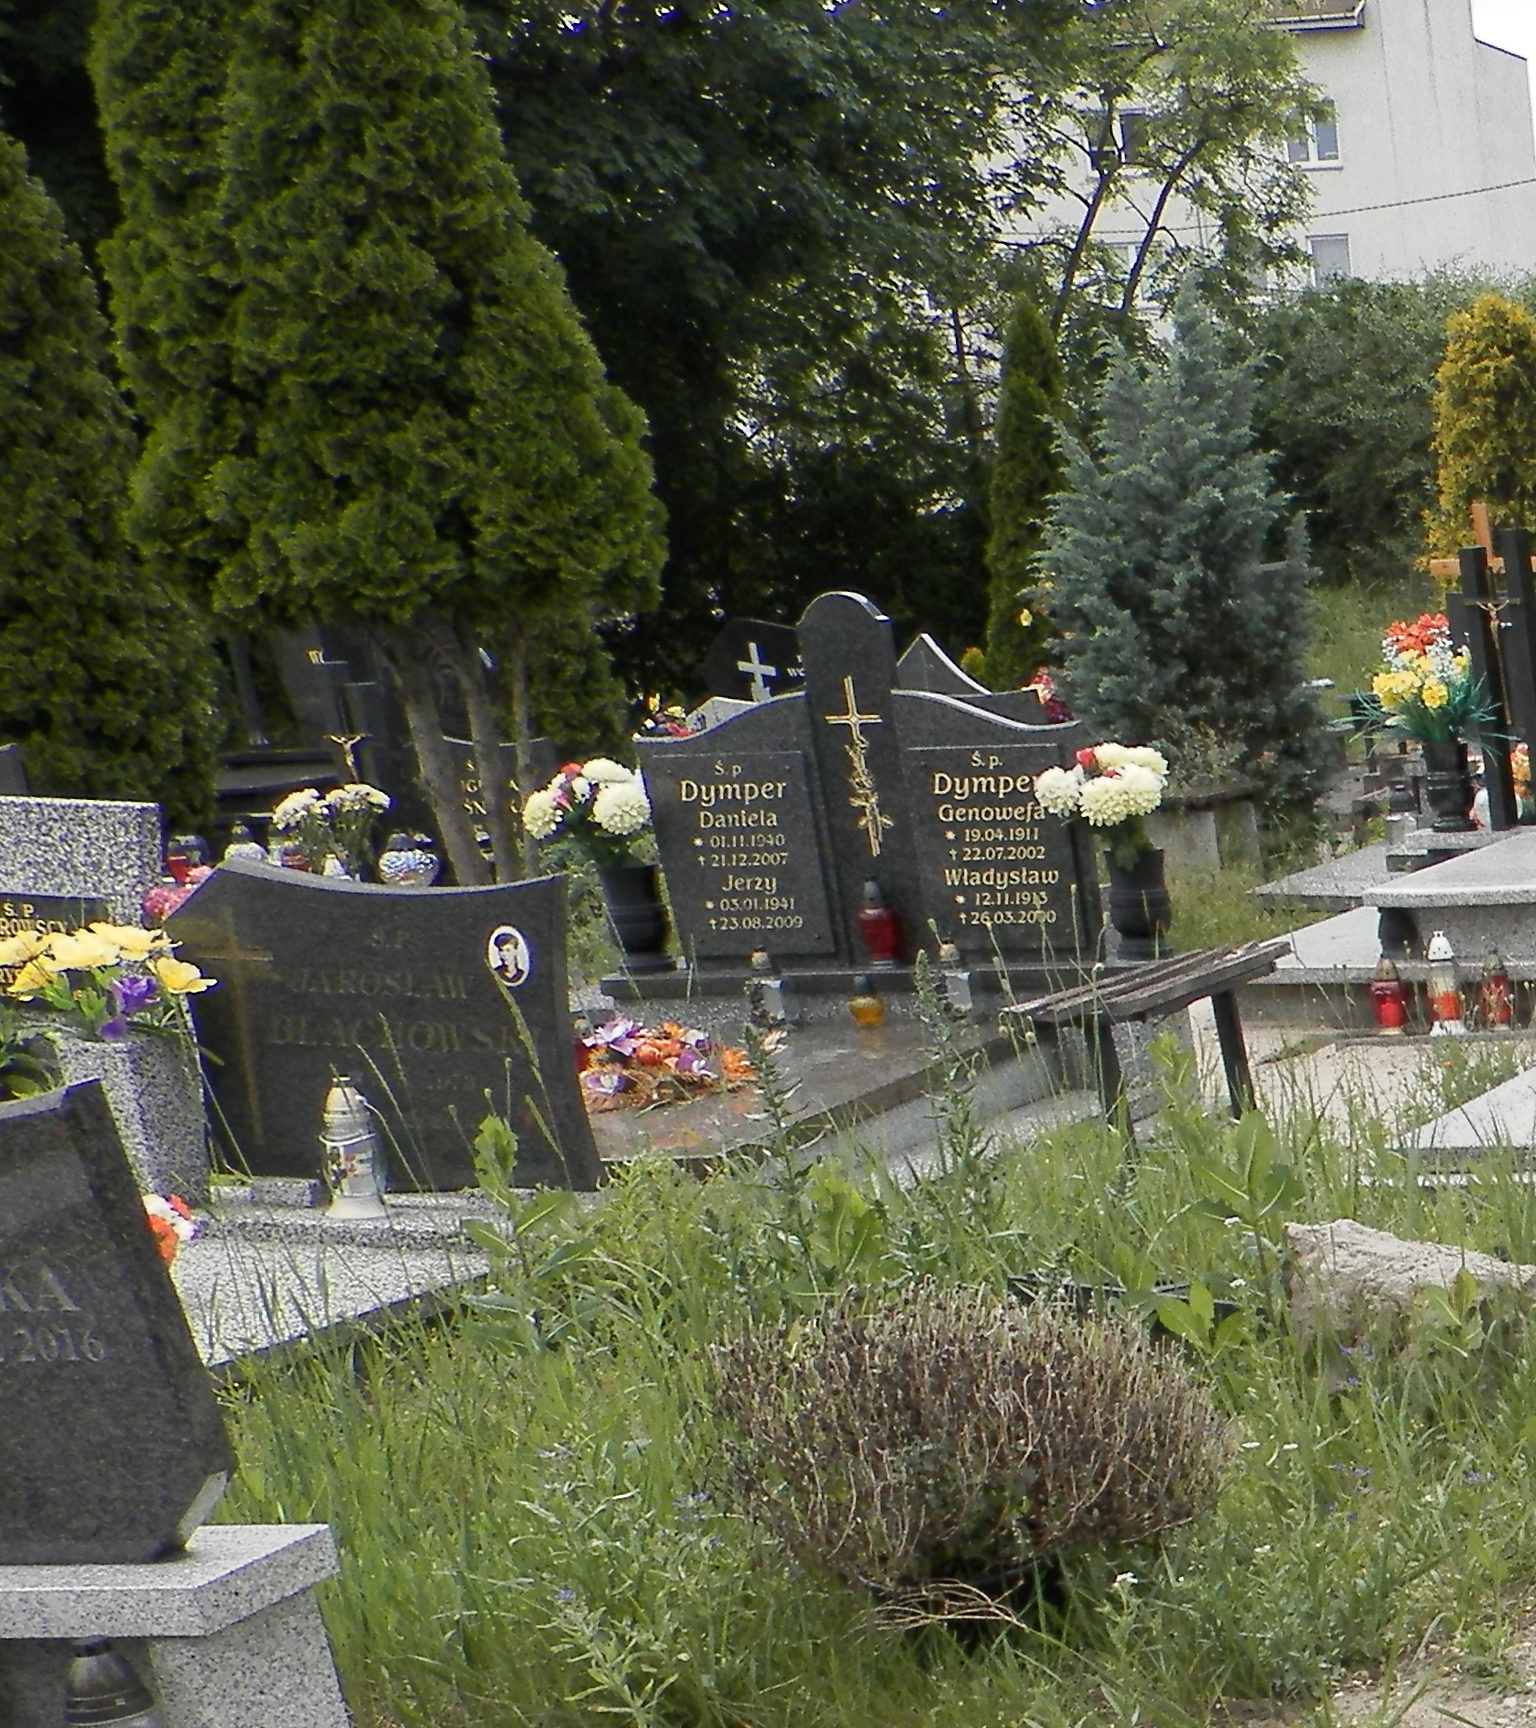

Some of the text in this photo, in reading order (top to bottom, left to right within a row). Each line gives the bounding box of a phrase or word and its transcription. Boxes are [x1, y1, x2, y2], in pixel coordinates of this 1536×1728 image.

[680, 779, 787, 807] Dymper
[933, 772, 1039, 801] Dympe
[699, 809, 778, 829] Daniela
[938, 801, 1046, 823] Genowefa
[710, 833, 786, 849] 01.11.1940
[965, 827, 1039, 843] 19.04.1911
[711, 852, 789, 868] 21.12.2007
[963, 846, 1046, 861] 22.07.2002
[721, 874, 777, 895] Jerzy
[944, 867, 1060, 890] Władysław
[720, 897, 795, 912] 03.01.1941
[720, 916, 804, 931] 23.08.2009
